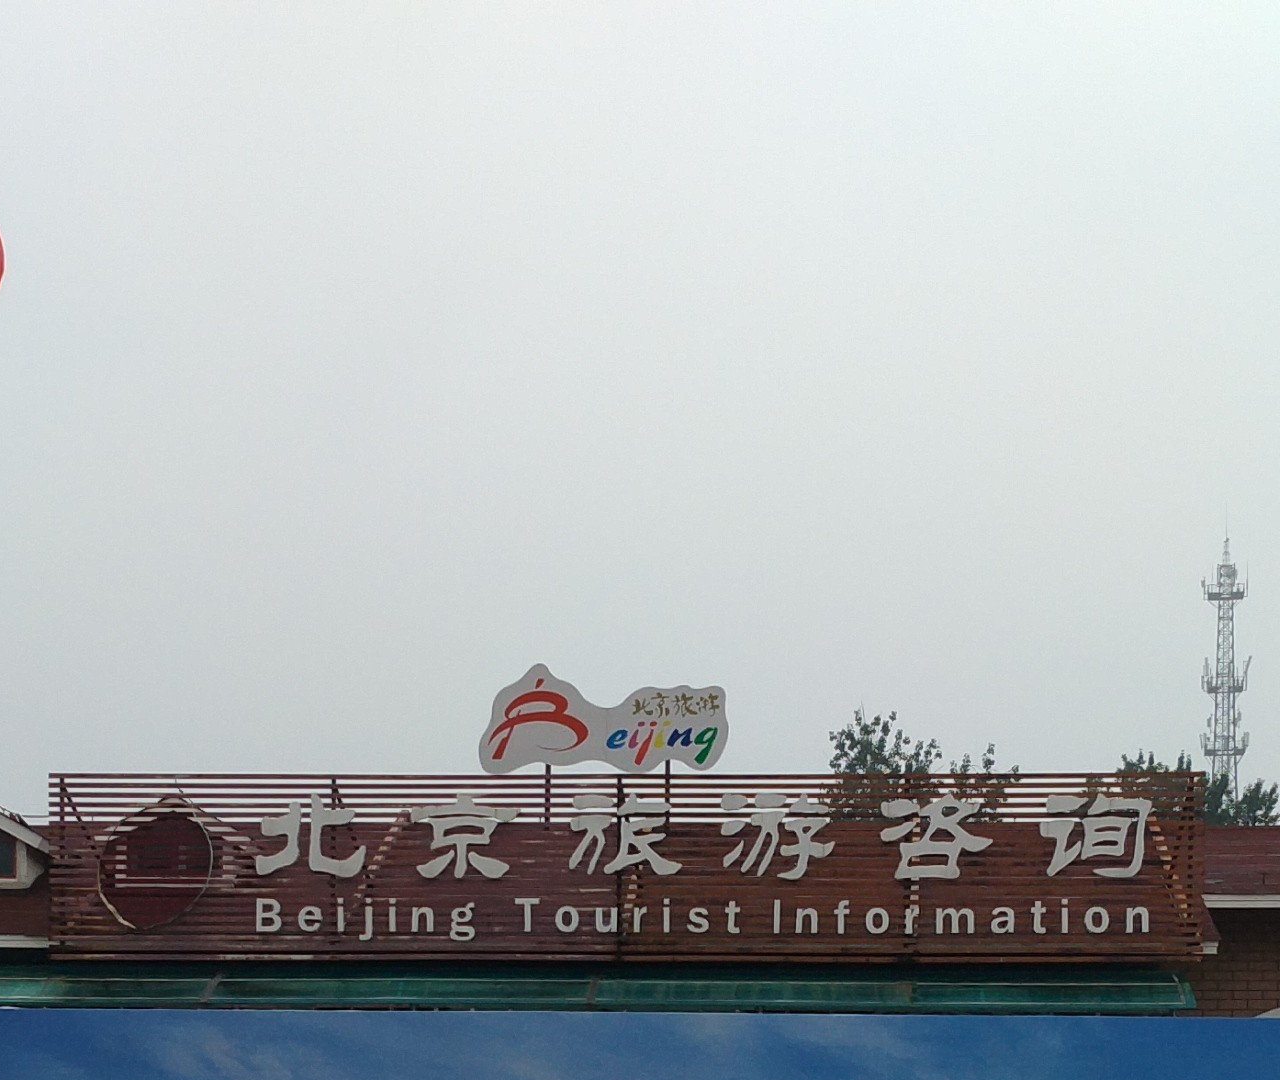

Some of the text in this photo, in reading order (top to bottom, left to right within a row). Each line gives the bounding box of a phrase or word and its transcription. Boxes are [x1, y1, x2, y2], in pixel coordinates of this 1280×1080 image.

[632, 692, 720, 718] 北京旅游
[256, 795, 1153, 880] 北京旅游咨询
[256, 897, 1152, 941] Beijing Tourist Information
